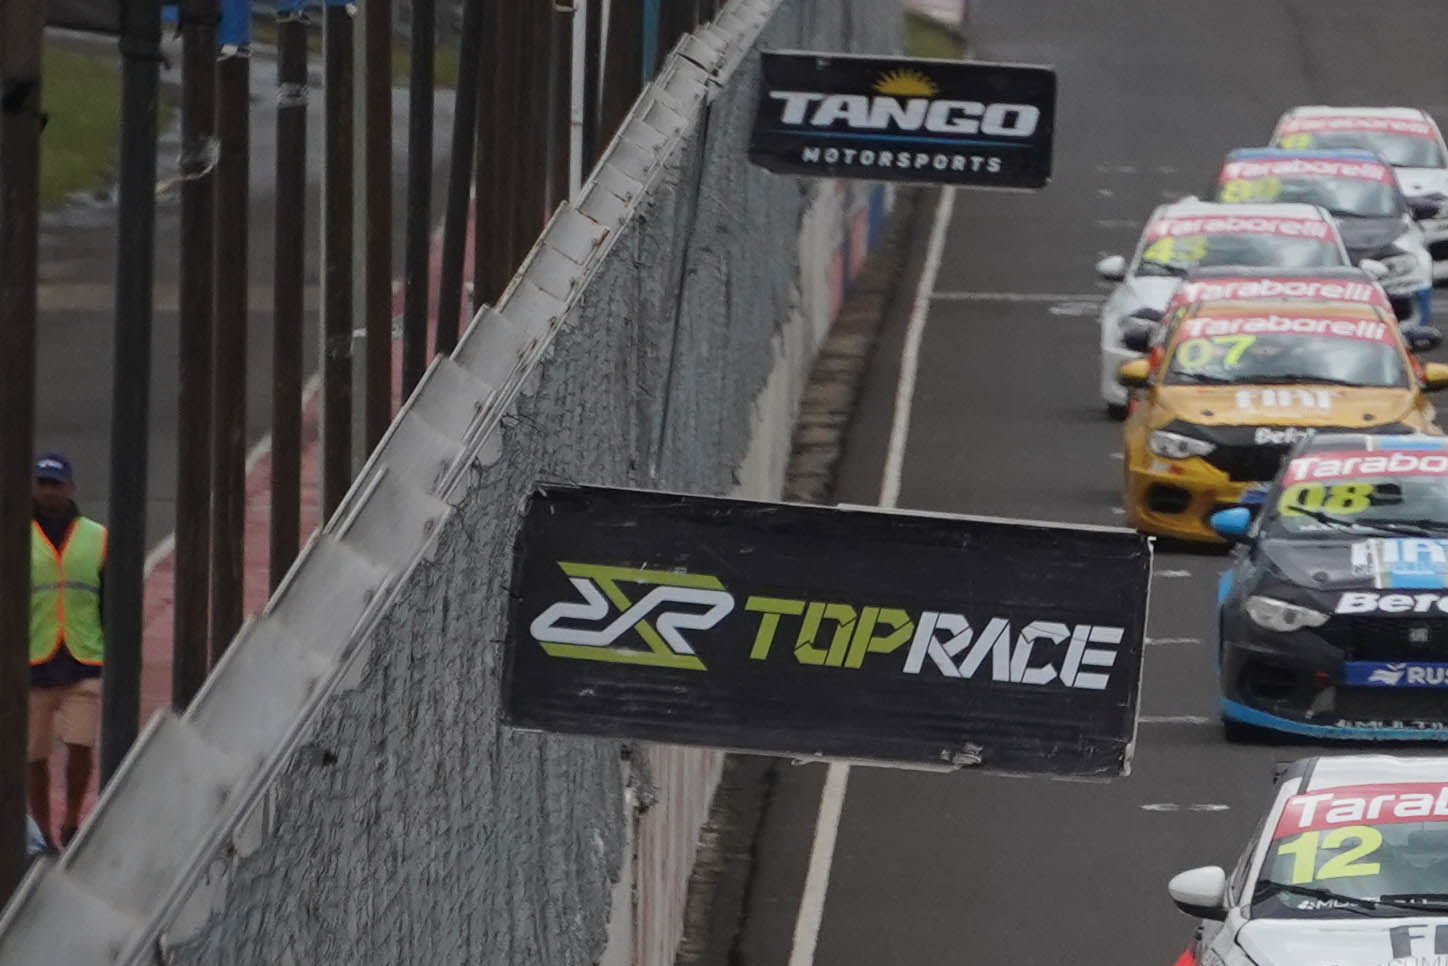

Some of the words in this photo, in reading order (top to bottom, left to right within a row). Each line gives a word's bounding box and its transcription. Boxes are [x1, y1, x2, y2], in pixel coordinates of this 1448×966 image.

[769, 90, 1041, 138] TANGO
[802, 146, 1002, 173] MOTORSPORTS
[1182, 278, 1372, 303] Taraborelli
[1185, 314, 1387, 340] Taraborelli
[1175, 333, 1257, 369] 07
[1278, 482, 1374, 517] 08
[1278, 825, 1384, 885] 12
